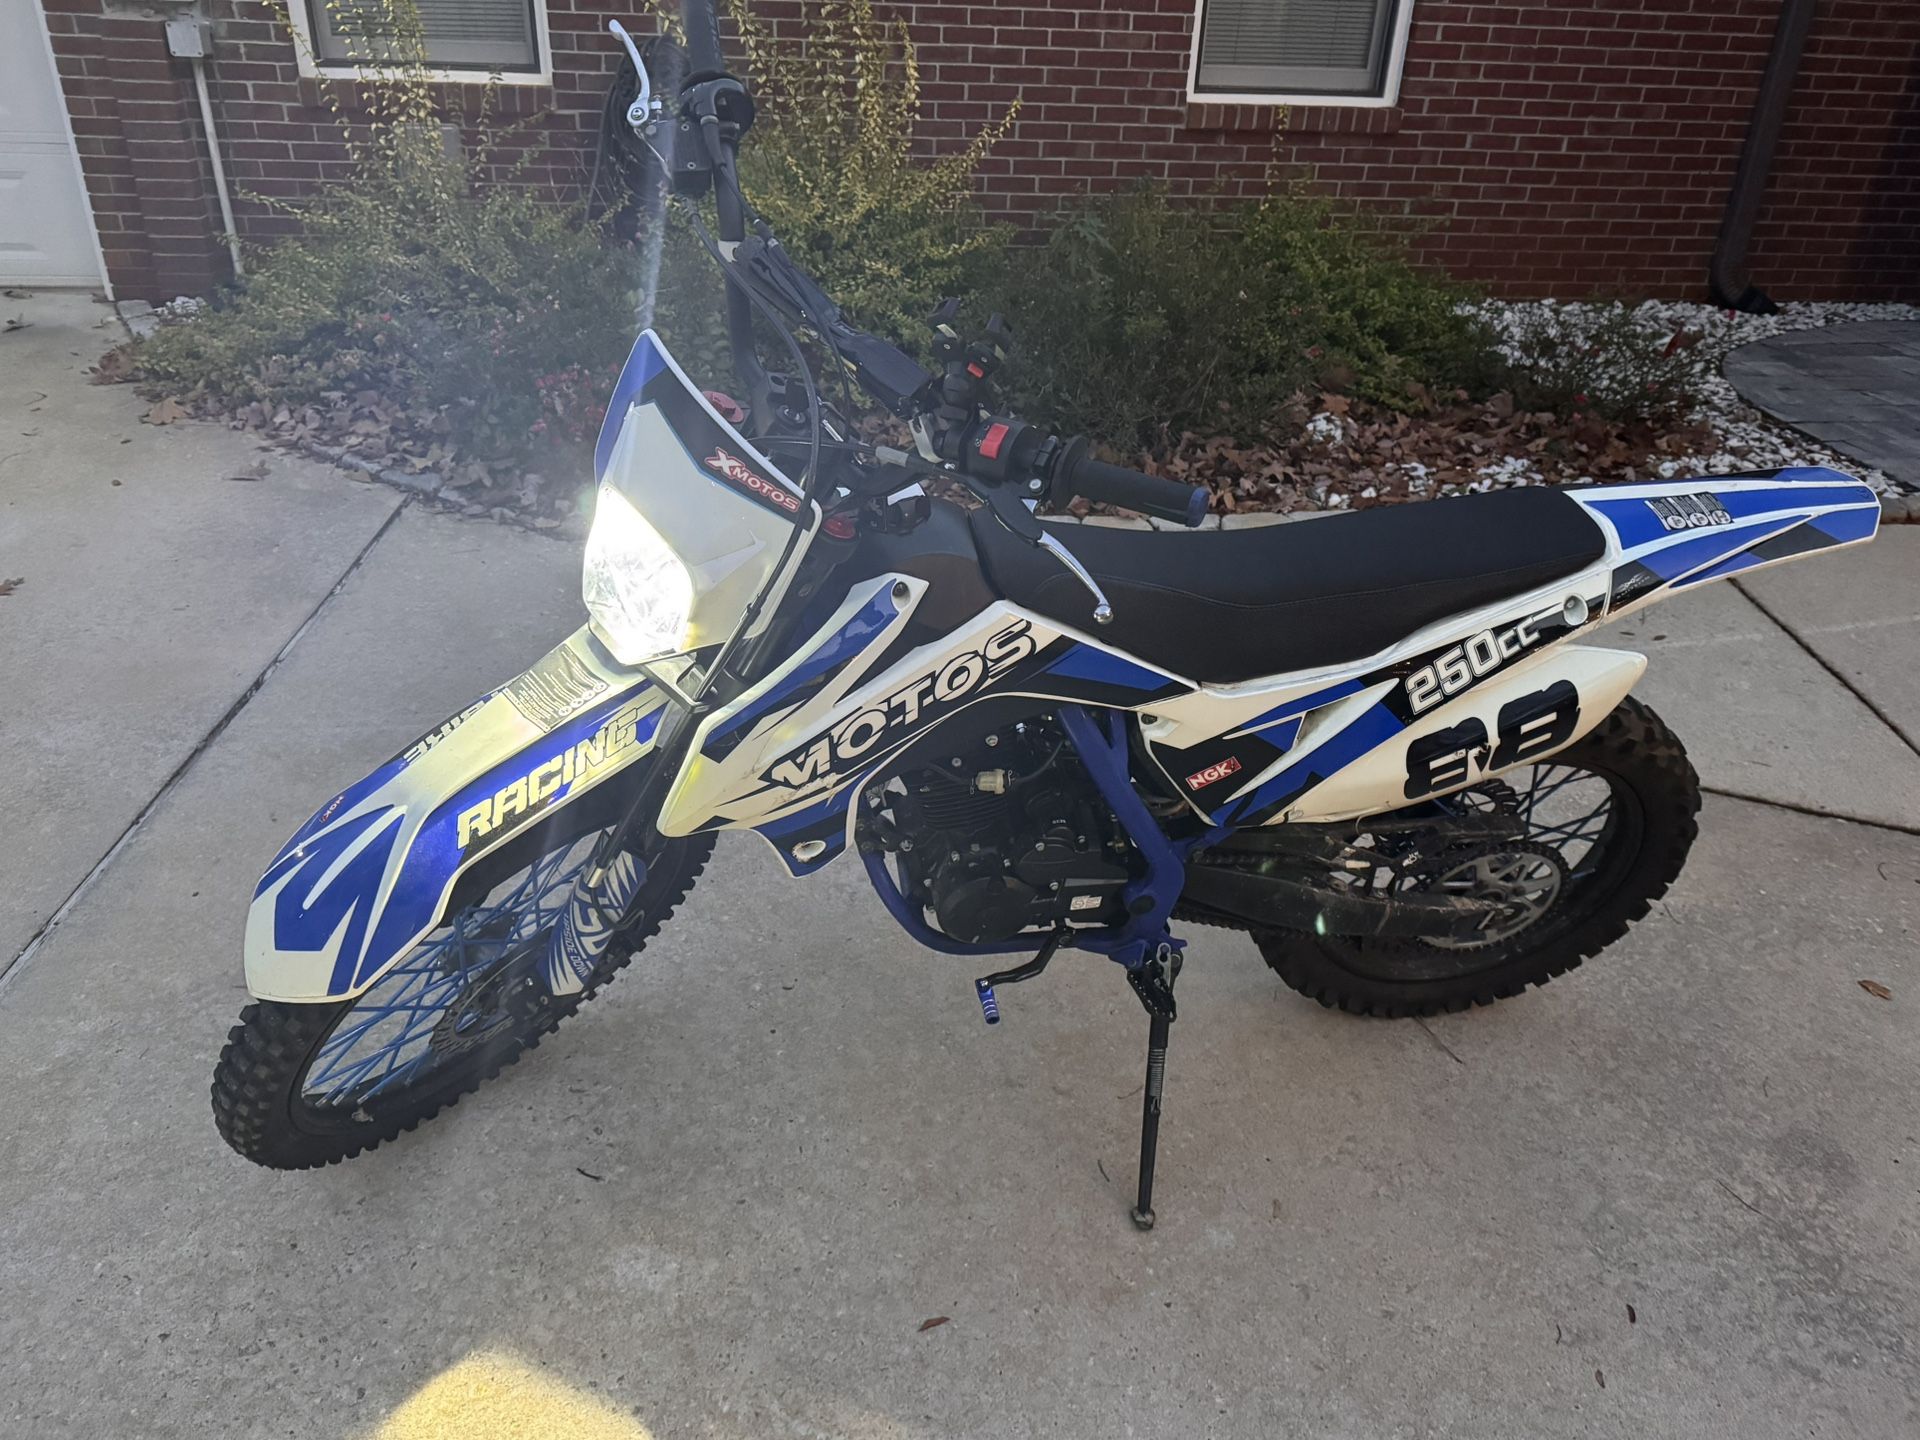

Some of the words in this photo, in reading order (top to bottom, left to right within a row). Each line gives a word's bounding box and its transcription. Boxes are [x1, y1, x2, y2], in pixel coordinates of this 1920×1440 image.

[705, 448, 800, 511] XMOTOS
[771, 620, 1035, 787] MOTOS
[457, 708, 638, 850] RACING
